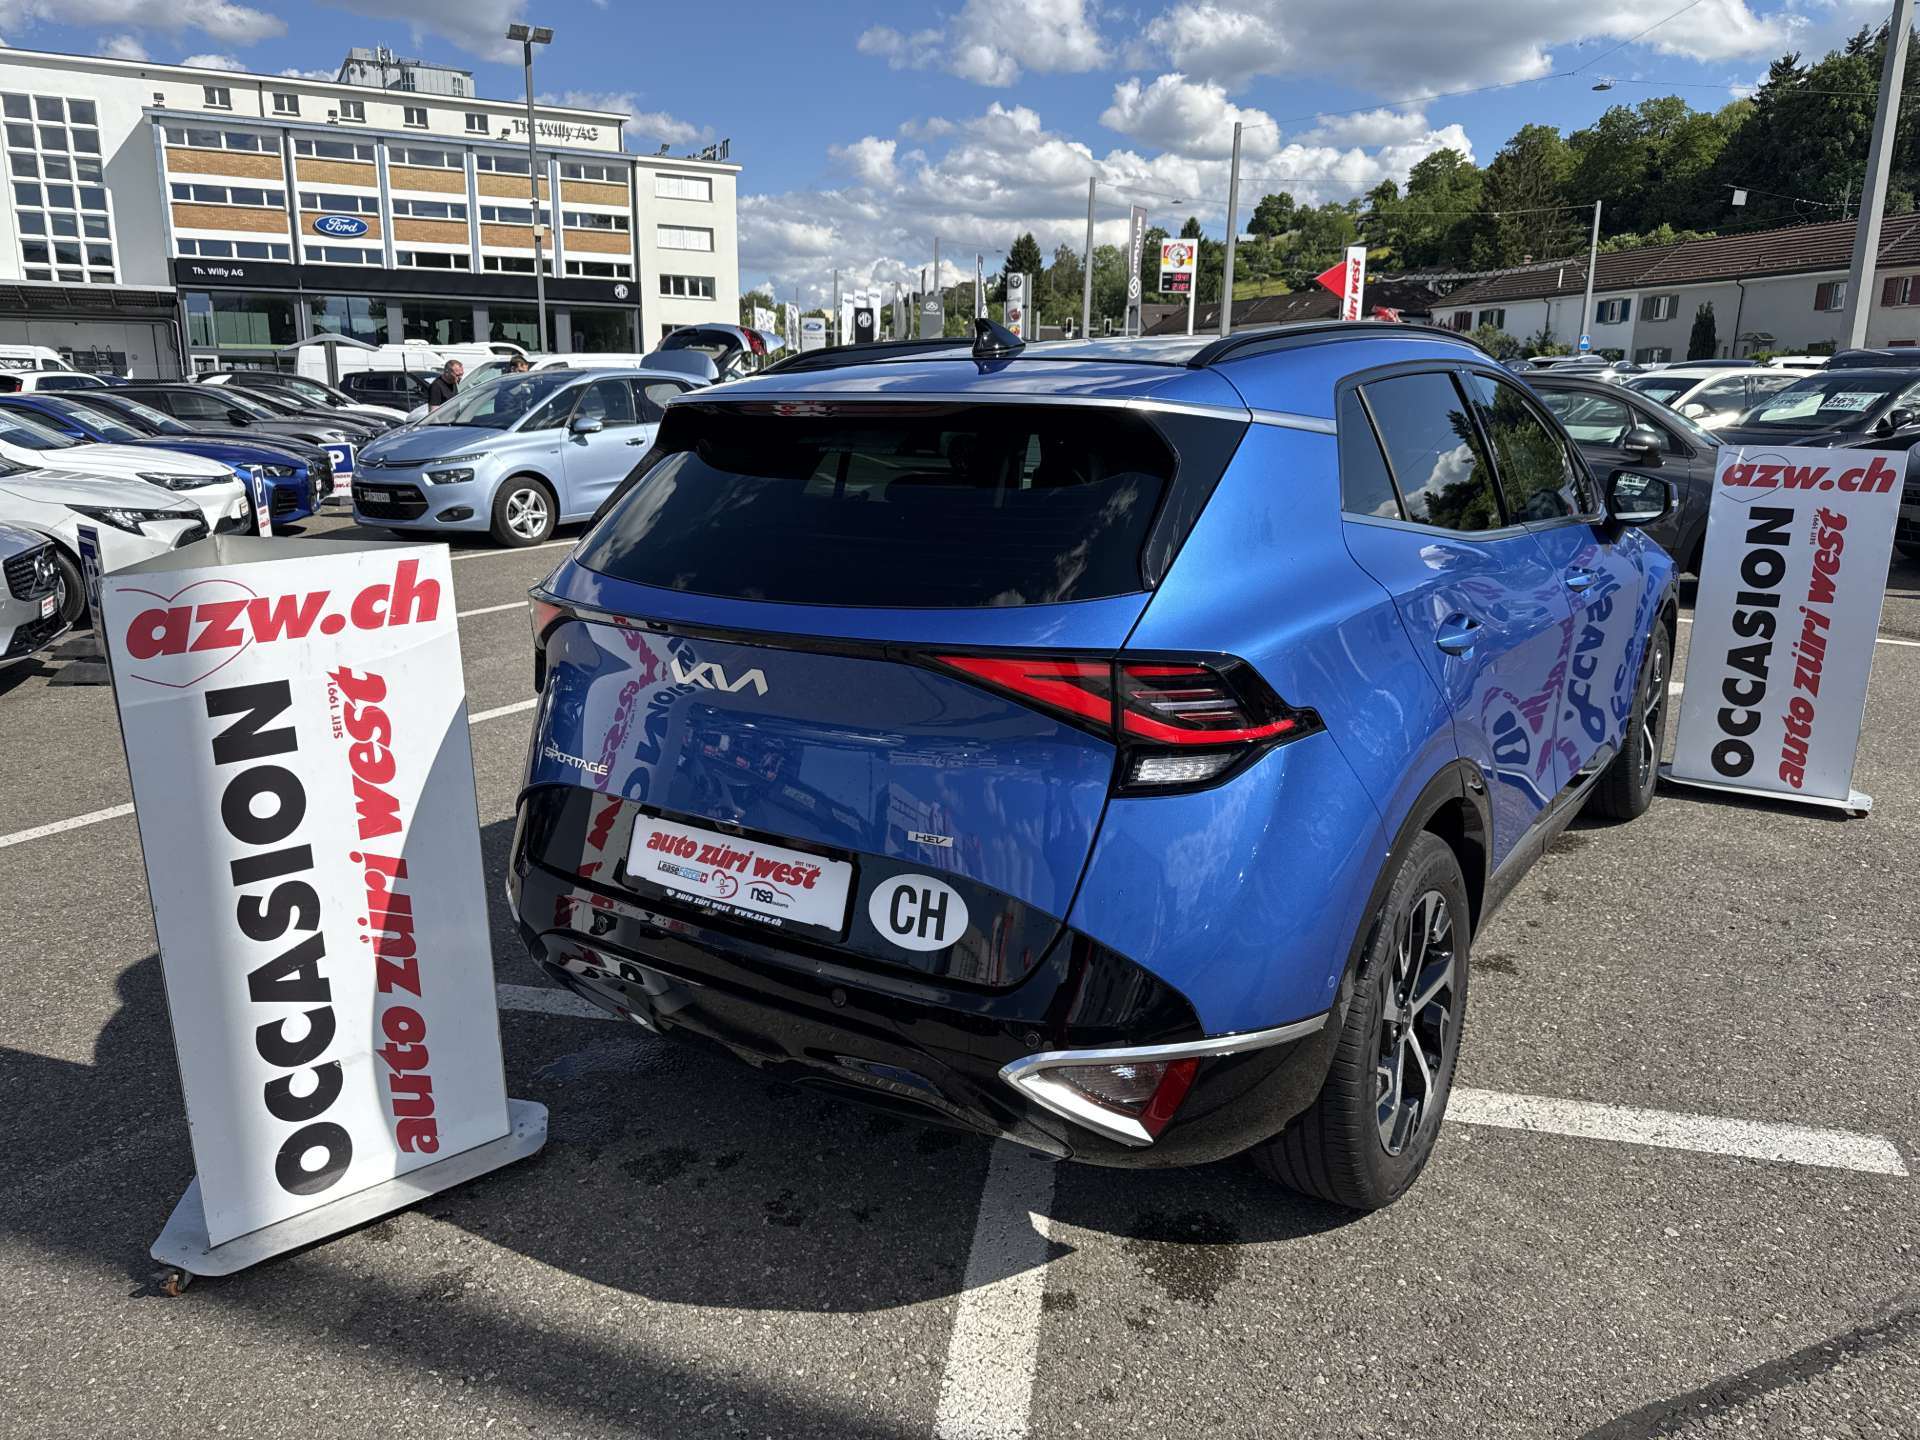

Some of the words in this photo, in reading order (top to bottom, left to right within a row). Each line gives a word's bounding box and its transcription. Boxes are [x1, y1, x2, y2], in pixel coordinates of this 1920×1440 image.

[325, 217, 358, 233] Ford
[192, 266, 206, 275] Th.
[207, 267, 229, 278] Willy
[231, 268, 244, 277] AG
[857, 311, 872, 328] MG
[328, 450, 344, 471] P
[1722, 457, 1897, 493] azw.ch
[255, 477, 263, 503] P
[1808, 506, 1848, 604] west
[125, 560, 442, 660] azw.ch
[1711, 507, 1795, 778] OCCASION
[1791, 605, 1831, 698] züri
[327, 681, 340, 710] 1991
[670, 658, 769, 697] KIA
[331, 714, 344, 739] SEIT
[1778, 696, 1816, 789] auto
[326, 664, 404, 841] west
[544, 746, 609, 776] SPORTAGE
[914, 833, 948, 845] HEV
[646, 830, 698, 859] auto
[695, 843, 754, 874] züri
[752, 856, 821, 890] west
[676, 891, 693, 901] auto
[711, 901, 731, 913] west
[734, 906, 783, 926] www.azw.ch
[750, 887, 774, 904] nsa
[889, 884, 949, 941] CH
[204, 679, 354, 1196] OCCASION
[349, 851, 423, 998] züri
[376, 1006, 441, 1156] auto
